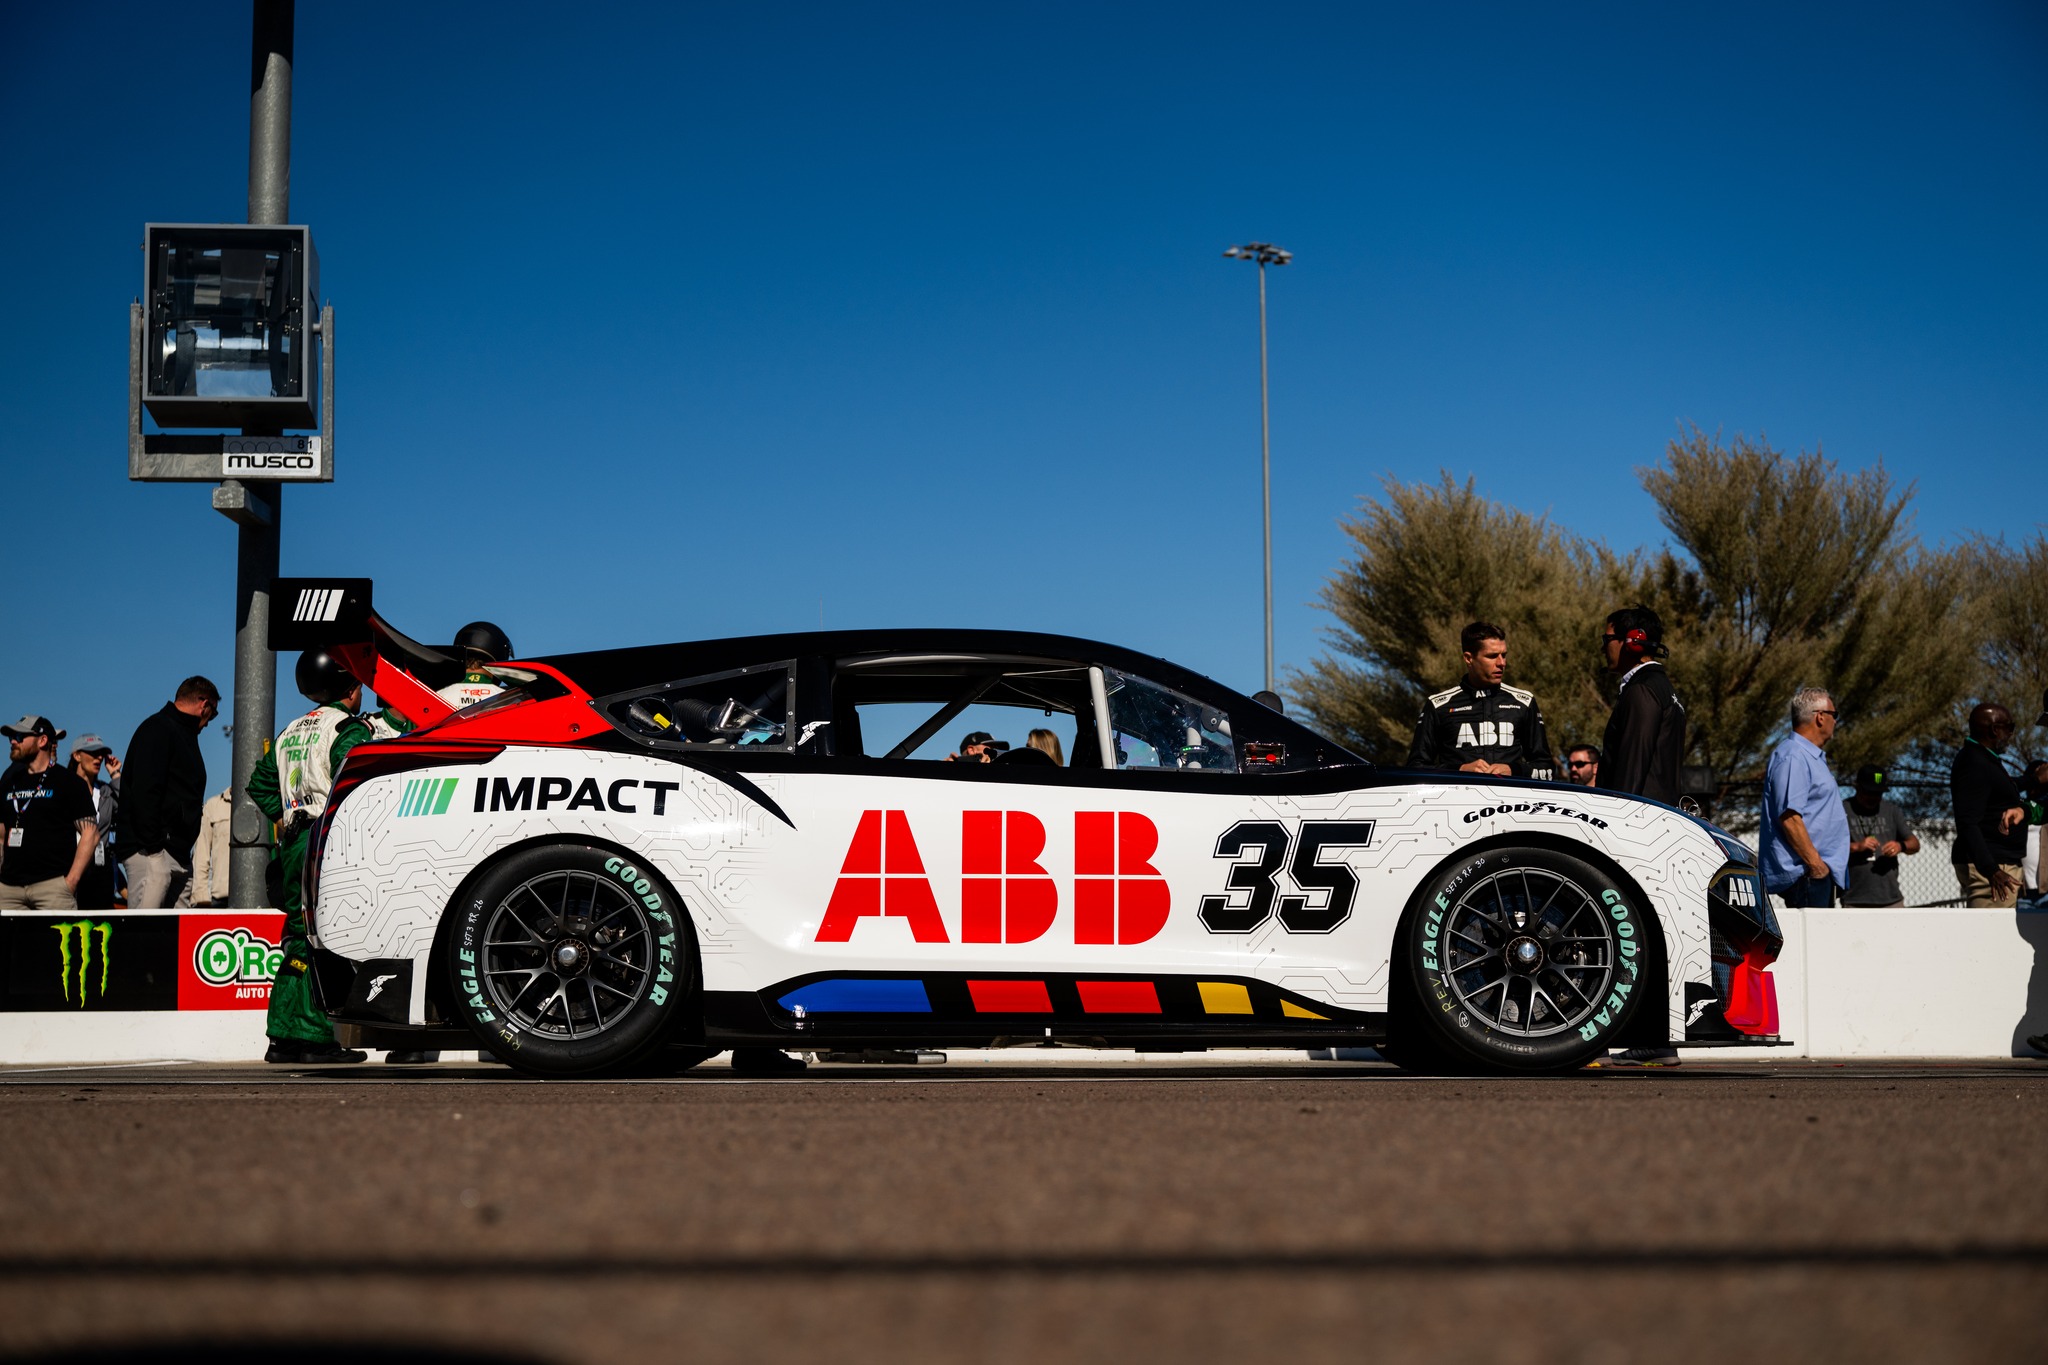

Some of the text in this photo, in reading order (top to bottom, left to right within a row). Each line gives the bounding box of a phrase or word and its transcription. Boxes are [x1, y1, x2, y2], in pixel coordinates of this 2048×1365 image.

[461, 688, 491, 697] TRD
[468, 674, 481, 682] 43
[1455, 721, 1514, 748] ABB
[473, 777, 680, 816] IMPACT
[1463, 802, 1609, 830] GOODYEAR
[814, 809, 1171, 945] ABB
[1197, 819, 1377, 935] 35
[1445, 878, 1458, 895] SET
[1728, 877, 1756, 907] ABB
[604, 857, 675, 1007] GOODYEAR
[1422, 891, 1450, 971] EAGLE
[1578, 888, 1639, 1042] GOODYEAR
[235, 987, 265, 999] AUTO
[460, 947, 496, 1024] EAGLE
[1429, 977, 1458, 1012] REV
